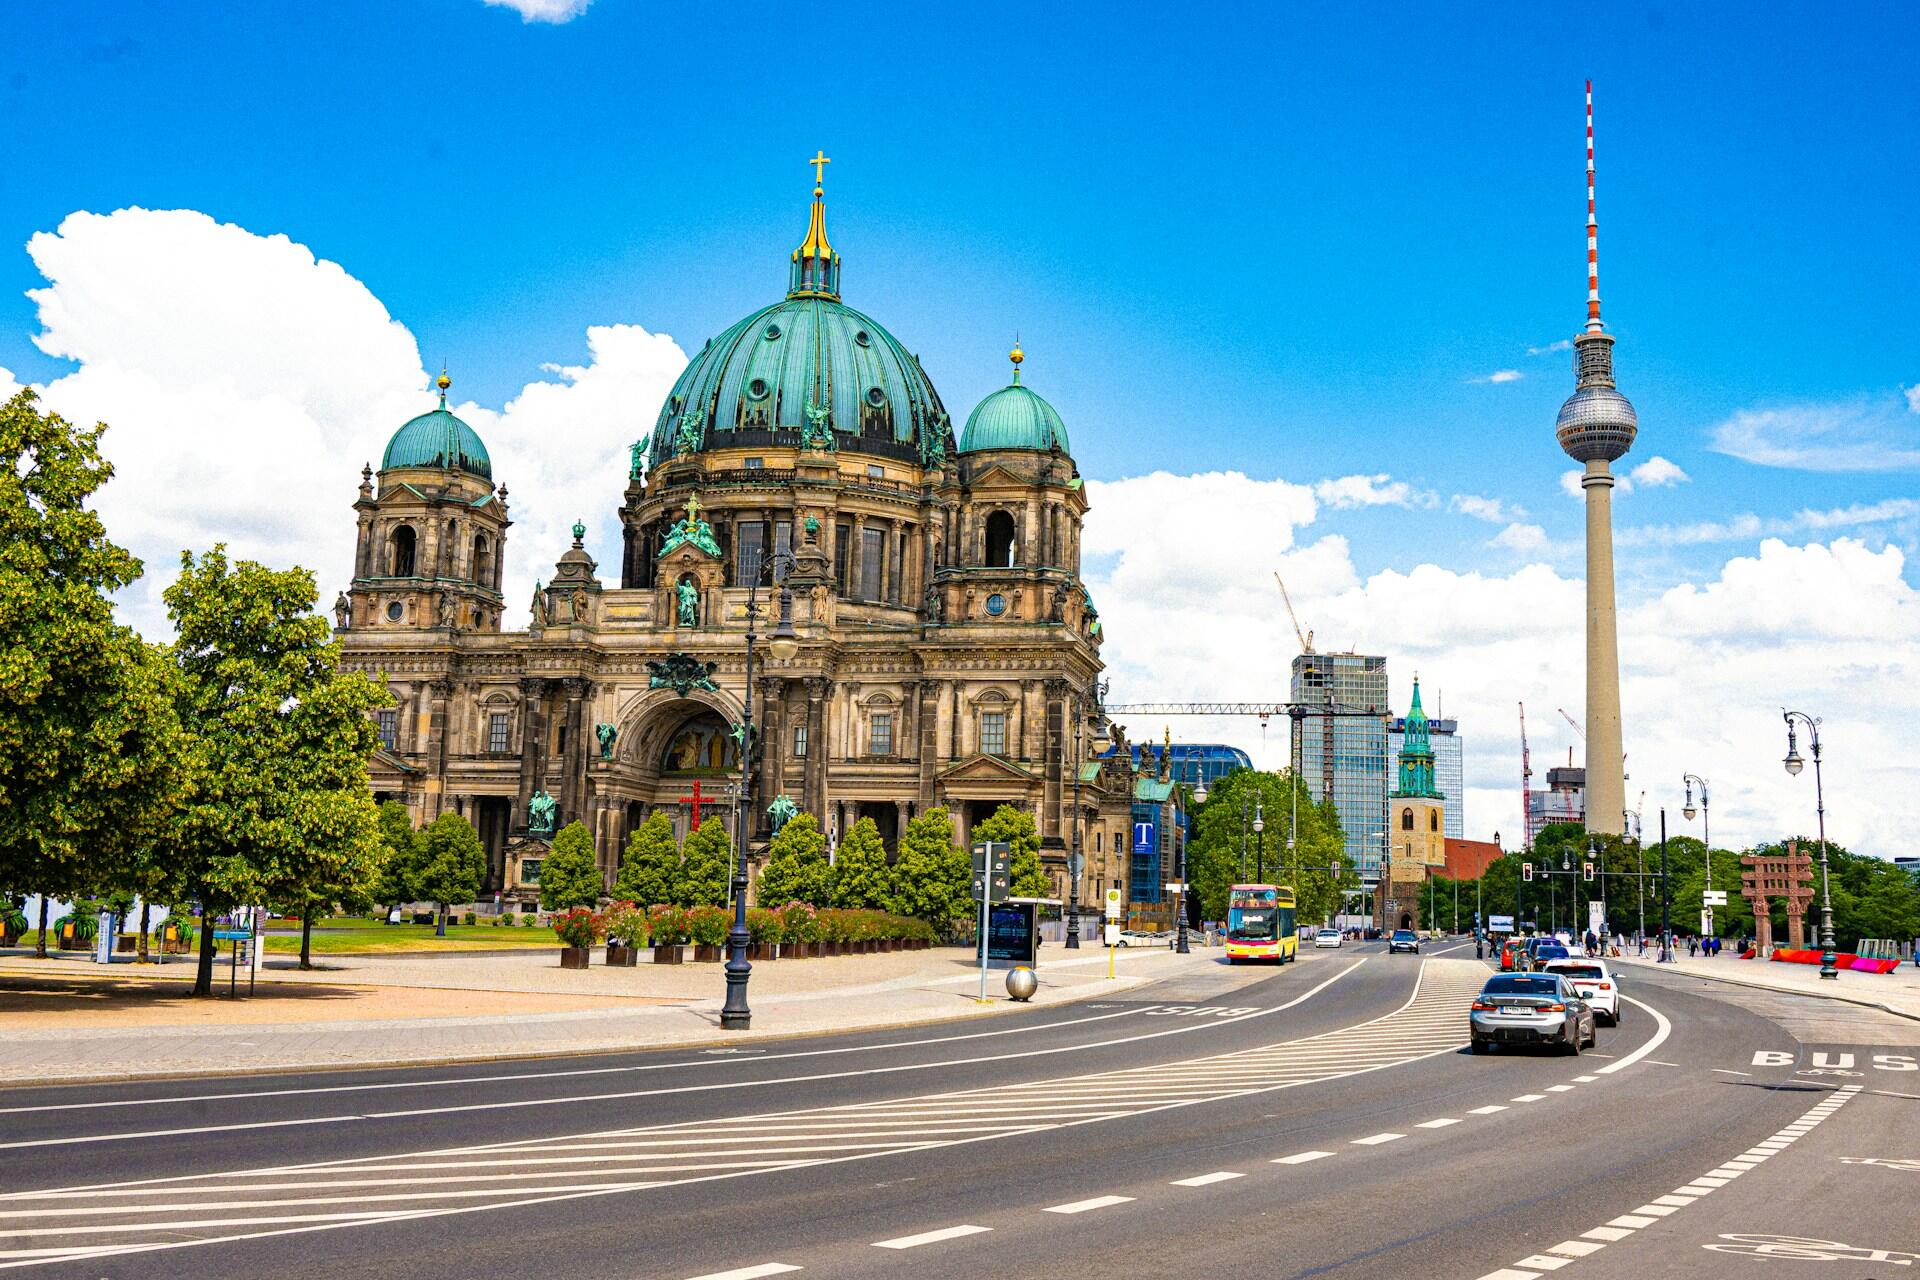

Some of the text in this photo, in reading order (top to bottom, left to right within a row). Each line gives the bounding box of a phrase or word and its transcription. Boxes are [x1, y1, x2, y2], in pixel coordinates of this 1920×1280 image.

[1135, 822, 1153, 845] T
[1146, 1006, 1262, 1017] BUS
[1751, 1050, 1919, 1071] BUS
